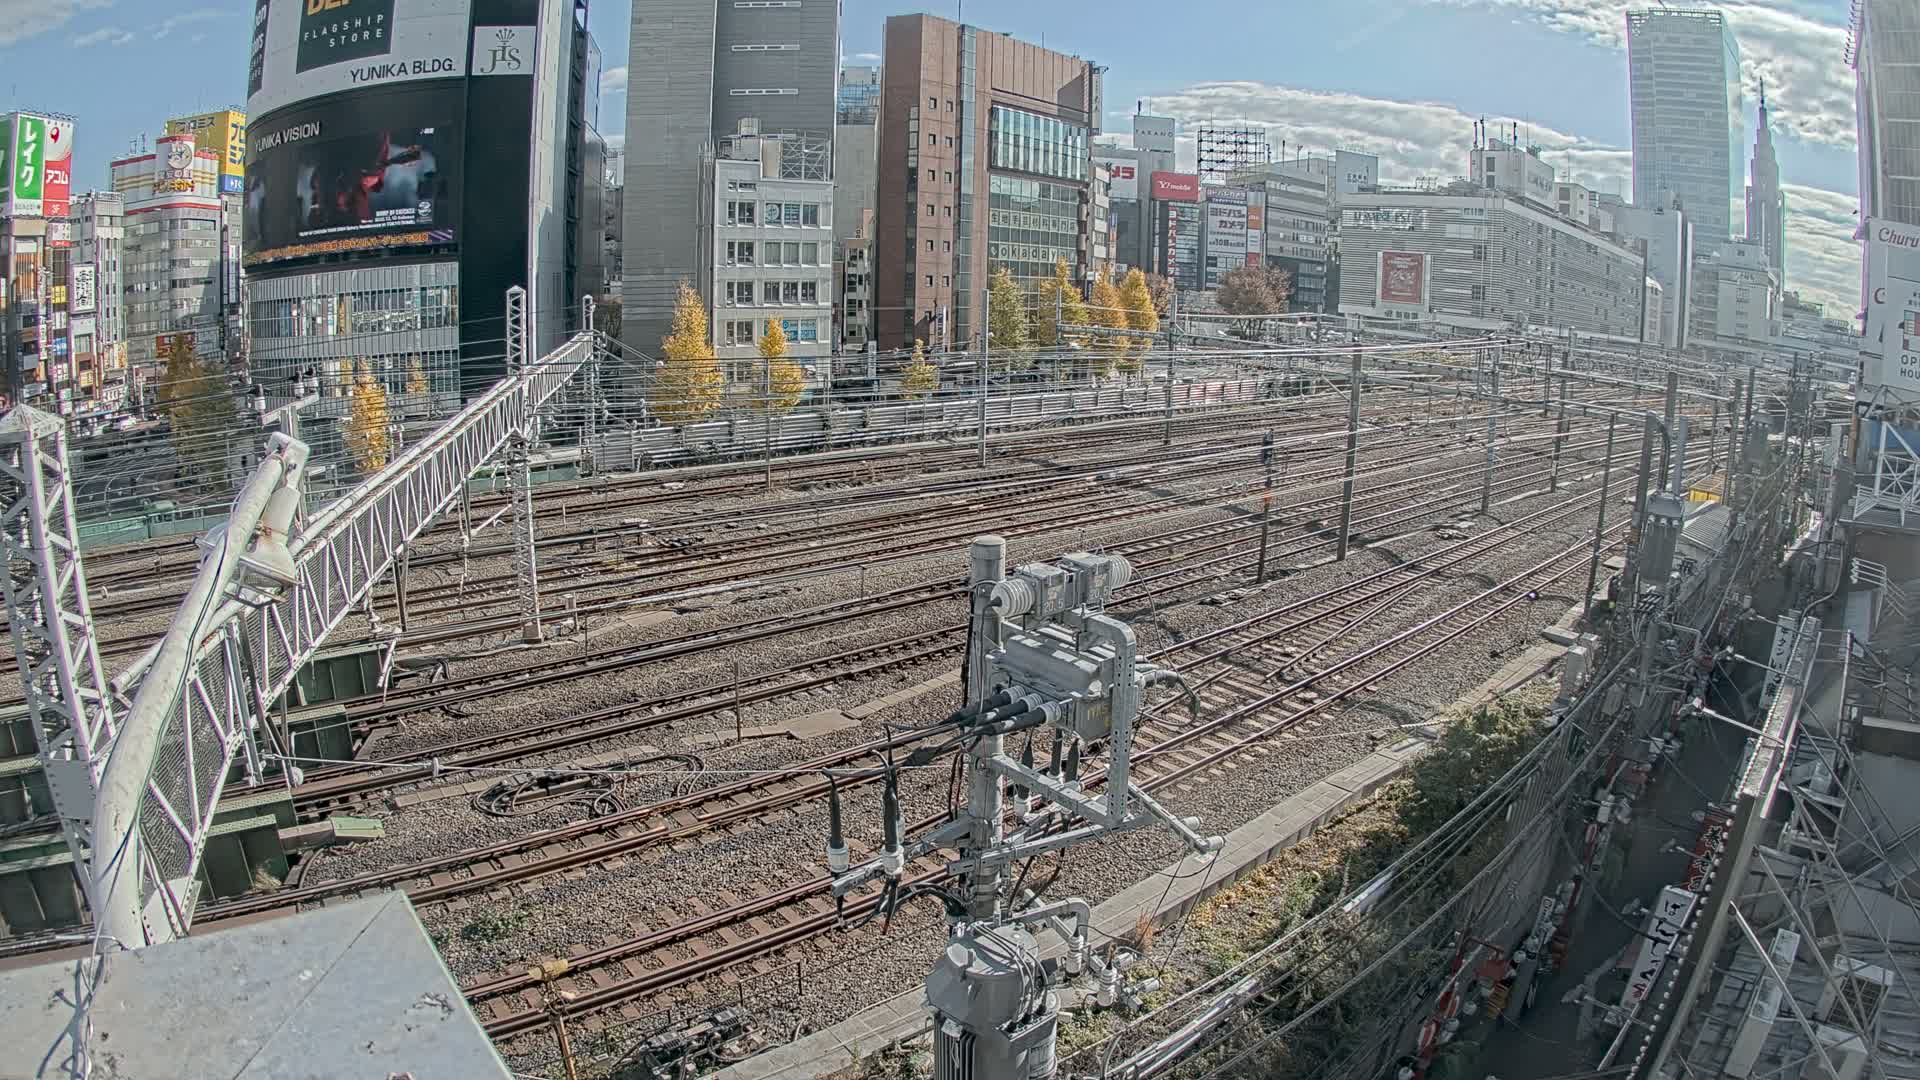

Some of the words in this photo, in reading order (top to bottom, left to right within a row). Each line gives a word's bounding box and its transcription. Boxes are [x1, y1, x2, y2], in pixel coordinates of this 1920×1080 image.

[304, 14, 384, 41] FLAGSHIP
[329, 28, 383, 48] STORE
[350, 61, 408, 83] YUNIKA
[412, 57, 456, 75] BLDG.
[255, 134, 281, 153] YUNIKA
[283, 121, 320, 143] VISION
[1136, 128, 1174, 138] TAKANO
[21, 120, 38, 189] レイク
[46, 168, 69, 185] アコム
[1878, 226, 1919, 248] Churu
[1901, 354, 1920, 368] OP
